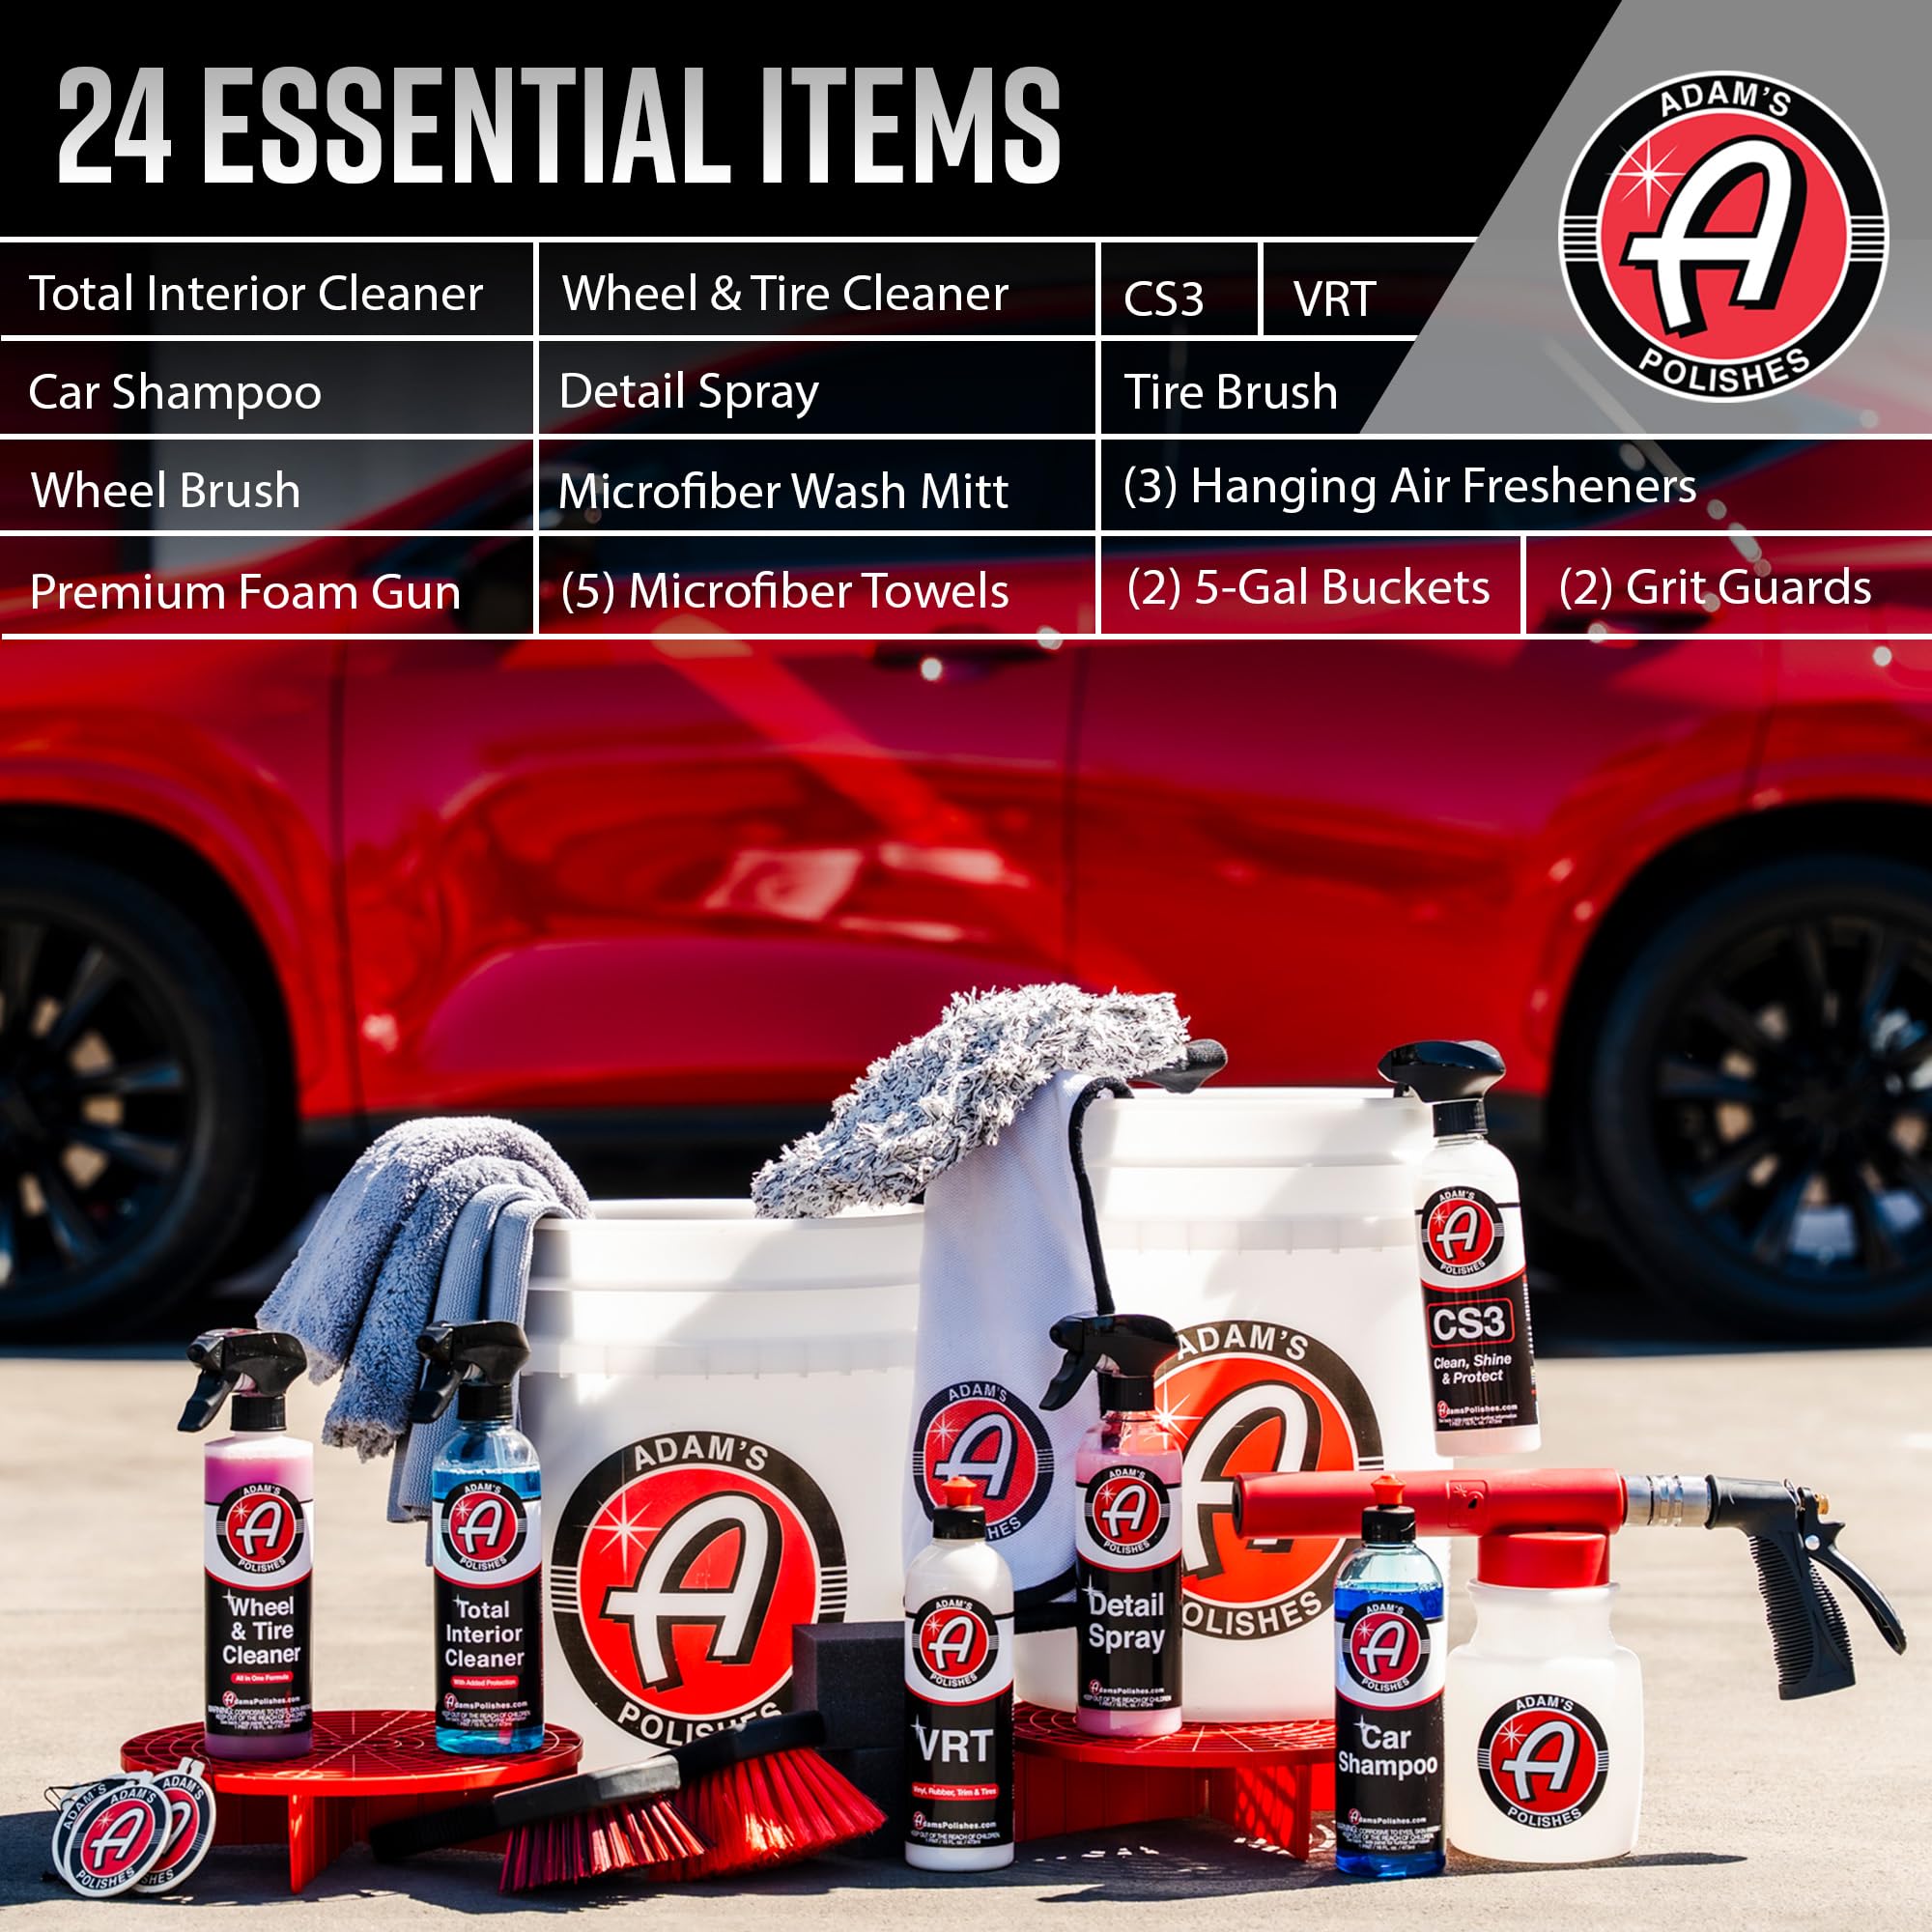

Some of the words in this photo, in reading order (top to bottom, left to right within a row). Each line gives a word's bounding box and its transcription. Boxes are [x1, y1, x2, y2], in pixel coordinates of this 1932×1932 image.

[1439, 1190, 1475, 1202] ADAM'S
[1440, 1260, 1485, 1275] POLISHES
[1433, 1305, 1506, 1341] CS3
[1177, 1323, 1309, 1361] ADAM'S
[1434, 1357, 1469, 1370] Clean,
[1473, 1353, 1512, 1367] Shine
[1442, 1373, 1450, 1384] &
[1453, 1370, 1503, 1383] Protect
[949, 1383, 1007, 1402] ADAM'S
[635, 1435, 769, 1471] ADAM'S
[1109, 1468, 1146, 1479] ADAM'S
[243, 1485, 281, 1495] ADAM'S
[465, 1483, 501, 1493] ADAM'S
[1104, 1540, 1150, 1554] POLISHES
[239, 1557, 286, 1573] POLISHES
[460, 1556, 507, 1571] POLISHES
[231, 1596, 294, 1616] Wheel
[460, 1600, 509, 1618] Total
[936, 1600, 973, 1610] ADAM'S
[1090, 1592, 1164, 1617] Detail
[1182, 1591, 1322, 1636] OLISHES
[1366, 1604, 1405, 1614] ADAM'S
[231, 1621, 246, 1640] &
[252, 1621, 294, 1640] Tire
[446, 1624, 523, 1642] Interior
[1089, 1623, 1165, 1654] Spray
[222, 1645, 301, 1664] Cleaner
[445, 1648, 525, 1667] Cleaner
[930, 1672, 978, 1687] POLISHES
[1361, 1678, 1409, 1692] POLISHES
[1516, 1695, 1574, 1712] ADAM'S
[1362, 1724, 1411, 1749] Car
[919, 1729, 994, 1763] VRT
[1339, 1750, 1437, 1780] Shampoo
[110, 1788, 156, 1805] ADAM'S
[162, 1776, 205, 1801] ADAM'S
[63, 1784, 106, 1830] ADAM'S
[1507, 1806, 1582, 1828] POLISHES
[76, 1867, 135, 1889] POLISHES
